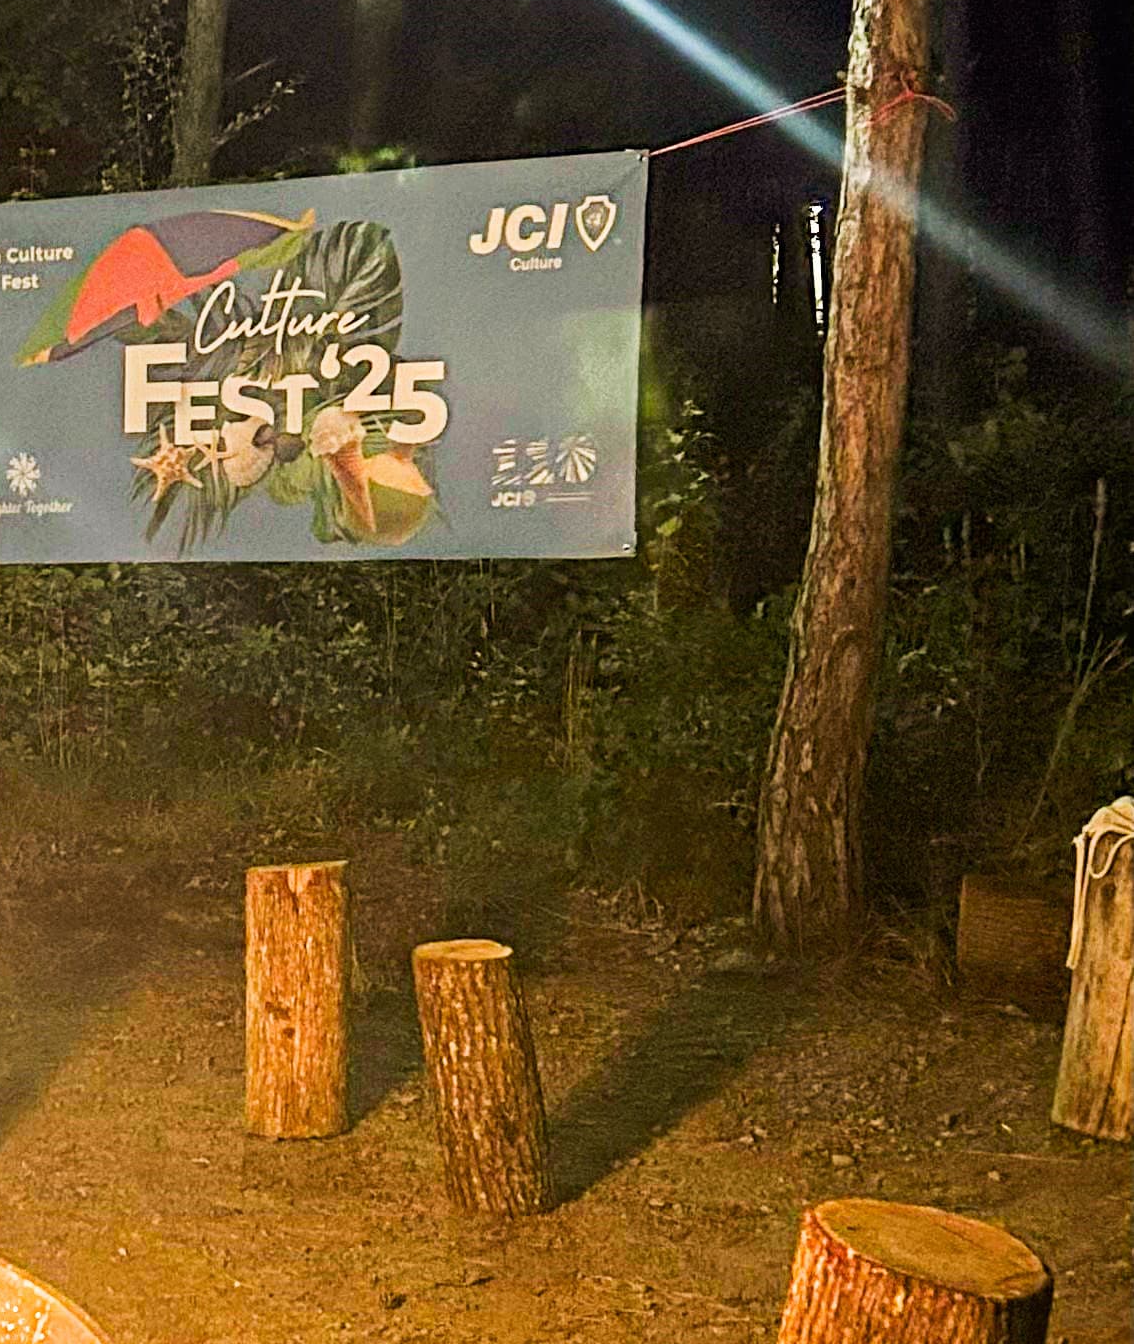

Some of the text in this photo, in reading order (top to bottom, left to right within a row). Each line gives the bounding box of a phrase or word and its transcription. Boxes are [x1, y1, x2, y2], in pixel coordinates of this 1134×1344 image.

[469, 203, 569, 255] JCI
[6, 246, 74, 264] Culture
[510, 257, 563, 272] Culture
[1, 274, 40, 290] Fest
[195, 269, 370, 355] Culture
